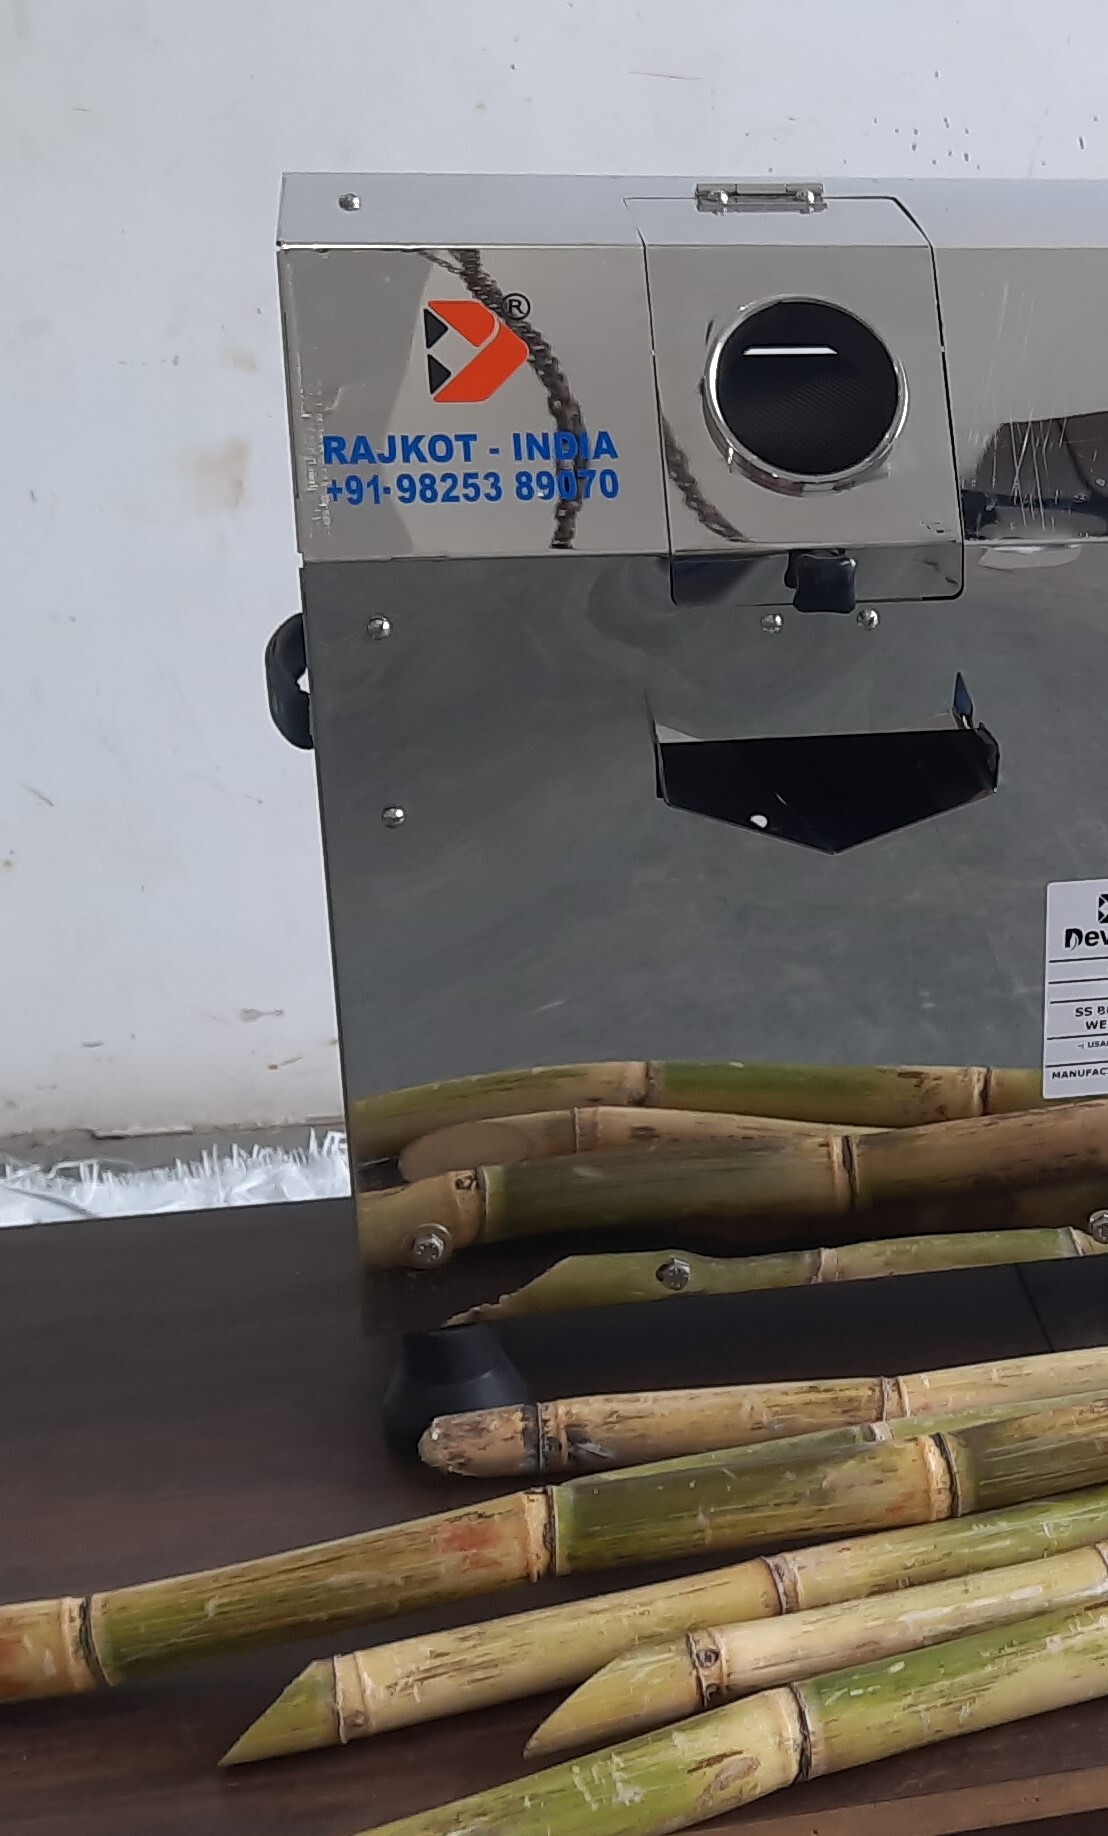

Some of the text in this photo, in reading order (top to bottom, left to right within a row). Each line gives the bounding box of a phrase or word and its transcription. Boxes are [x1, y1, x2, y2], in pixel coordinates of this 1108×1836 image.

[323, 433, 477, 464] RAJKOT
[513, 431, 618, 460] INDIA
[327, 469, 619, 505] +91-98253 89070
[1074, 1006, 1092, 1017] SS
